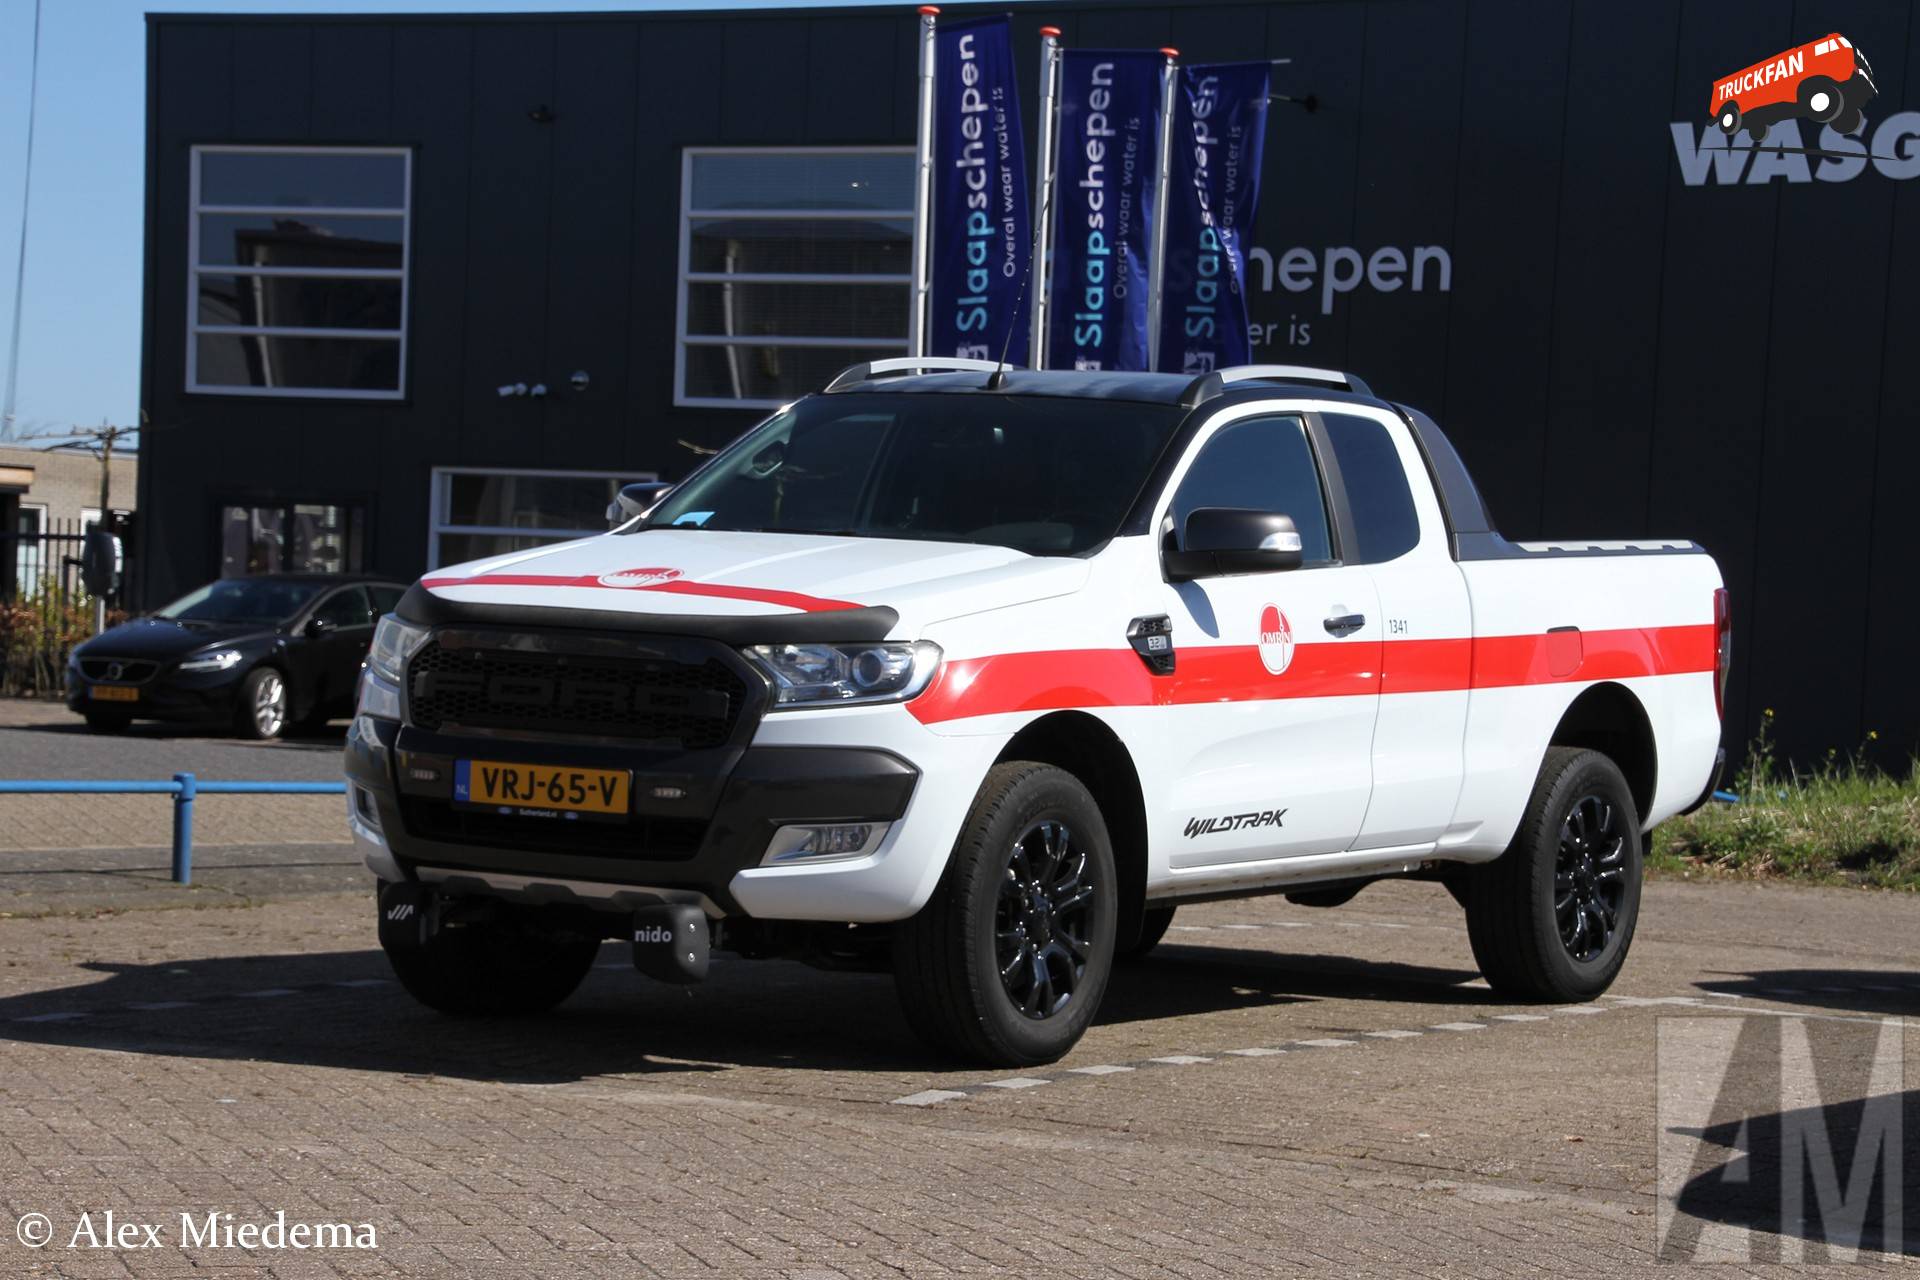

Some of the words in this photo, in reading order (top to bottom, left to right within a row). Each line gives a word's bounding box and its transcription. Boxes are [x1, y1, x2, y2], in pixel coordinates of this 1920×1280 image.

[992, 87, 1003, 100] is
[994, 106, 1010, 160] water
[1125, 117, 1141, 130] is
[1122, 135, 1138, 186] water
[956, 34, 995, 331] Slaapschepen
[1000, 166, 1014, 213] waar
[1074, 62, 1115, 347] Slaapschepen
[1118, 191, 1132, 236] waar
[1003, 218, 1016, 277] Overal
[1113, 241, 1128, 299] Overal
[1289, 314, 1311, 345] is
[1389, 619, 1408, 634] 1341
[456, 784, 468, 795] NL
[482, 767, 618, 807] VRJ-65-V
[1184, 808, 1288, 839] WILDTRAK
[635, 926, 672, 943] nido
